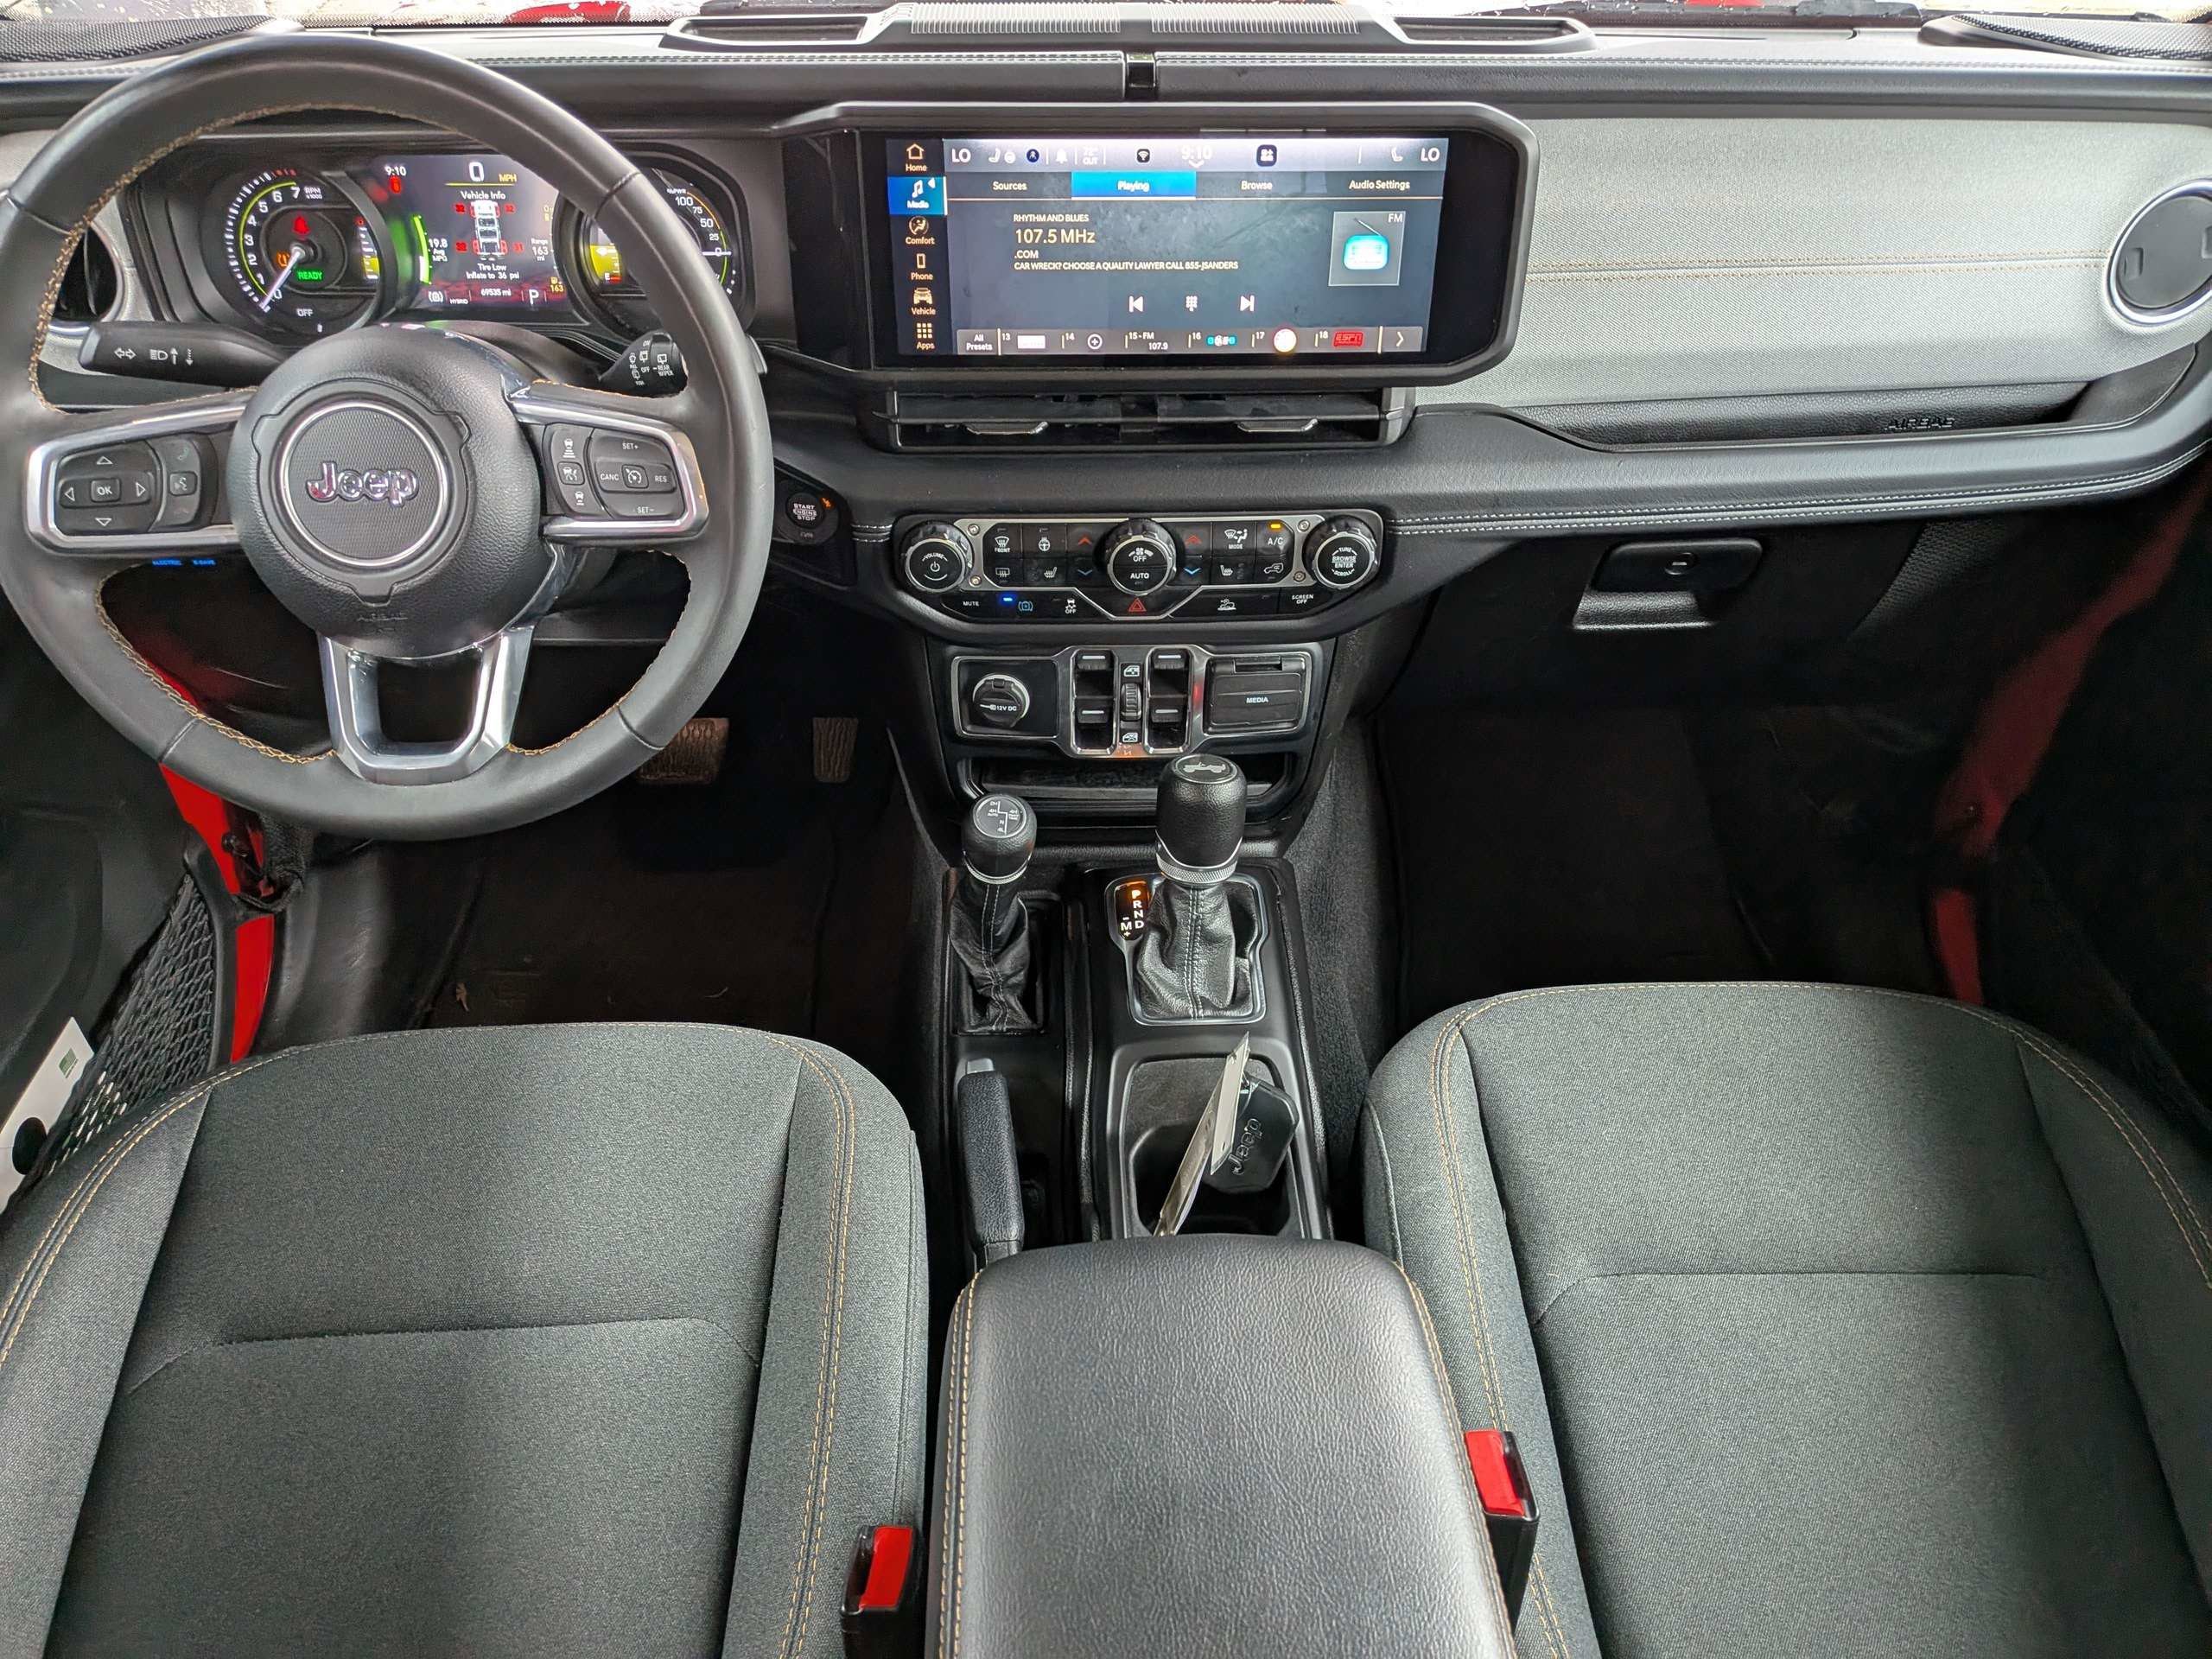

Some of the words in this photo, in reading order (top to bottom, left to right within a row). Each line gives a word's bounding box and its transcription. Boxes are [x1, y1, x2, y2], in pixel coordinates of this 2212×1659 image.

[951, 149, 971, 162] LO
[1421, 148, 1440, 162] LO
[1082, 156, 1098, 165] OUT
[385, 165, 406, 176] 9:10
[468, 162, 484, 181] 0
[906, 163, 927, 172] Home
[499, 174, 517, 182] MPH
[993, 181, 1027, 191] Sources
[1117, 181, 1150, 193] Playing
[1241, 181, 1273, 190] Browse
[1349, 180, 1375, 190] Audio
[1375, 180, 1410, 191] Settings
[272, 191, 283, 203] 6
[290, 187, 300, 199] 7
[461, 191, 489, 200] Vehicle
[490, 191, 505, 200] Info
[675, 196, 694, 206] 100
[258, 201, 268, 213] 5
[247, 215, 257, 226] 4
[1013, 213, 1046, 222] RHYTHM
[1046, 213, 1065, 222] AND
[1065, 213, 1089, 222] BLUES
[1388, 213, 1403, 223] FM
[700, 218, 713, 228] 50
[244, 234, 254, 246] 3
[1015, 228, 1058, 244] 107.5
[1060, 228, 1096, 244] MHz
[429, 238, 448, 248] 19.8
[532, 246, 549, 256] 163
[1014, 250, 1039, 258] .COM
[247, 254, 257, 266] 2
[1014, 262, 1030, 270] CAR
[1031, 262, 1062, 270] WRECK?
[1063, 262, 1095, 270] CHOOSE
[1096, 262, 1102, 270] A
[1102, 261, 1134, 270] QUALITY
[1135, 261, 1165, 270] LAWYER
[1166, 261, 1184, 270] CALL
[297, 271, 323, 280] READY
[911, 272, 933, 281] Phone
[529, 289, 539, 304] P
[296, 308, 313, 317] OFF
[911, 307, 936, 315] Vehicle
[1192, 332, 1201, 340] 16
[916, 341, 935, 351] Apps
[307, 461, 418, 508] Jeep
[96, 486, 112, 496] OK
[1131, 889, 1141, 899] P
[1134, 910, 1144, 918] N
[1120, 921, 1132, 931] M
[1135, 920, 1144, 929] D
[1228, 1118, 1262, 1175] Jeep
